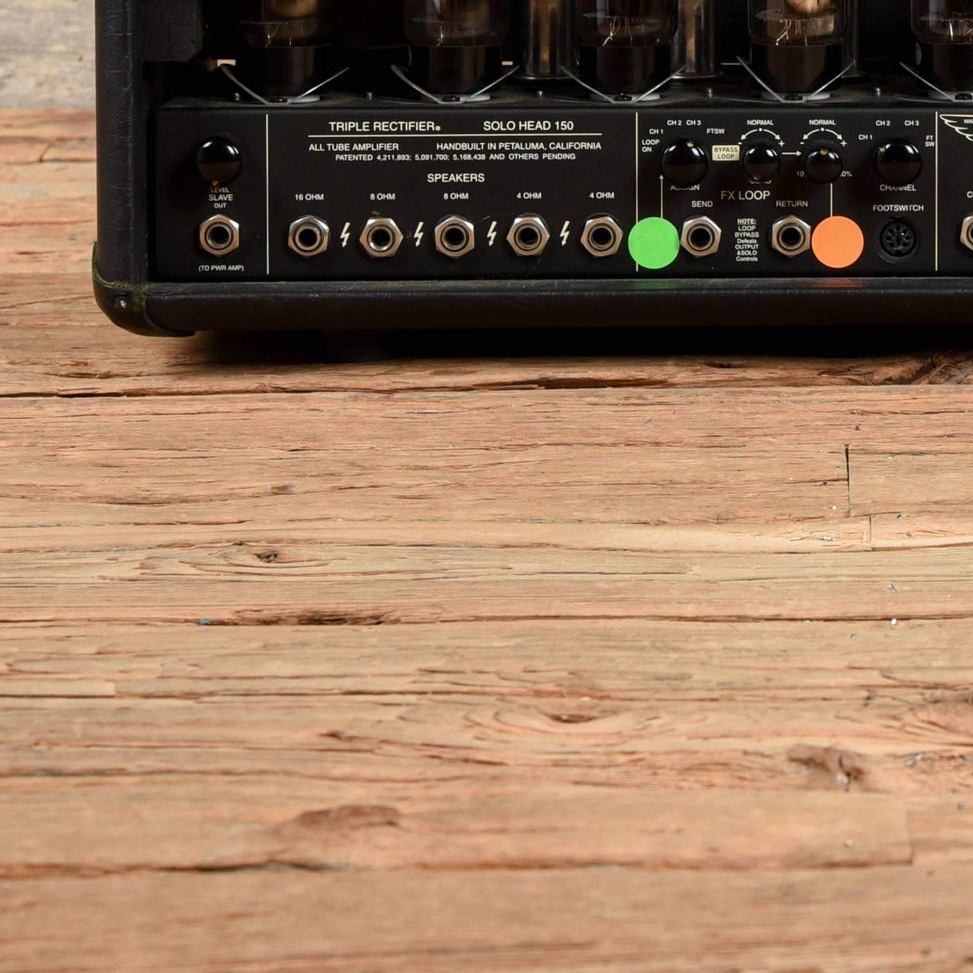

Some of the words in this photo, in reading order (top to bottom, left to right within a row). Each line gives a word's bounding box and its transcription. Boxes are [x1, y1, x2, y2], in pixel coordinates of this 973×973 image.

[329, 122, 370, 132] TRIPLE
[483, 120, 516, 131] SOLO
[519, 120, 551, 130] HEAD
[555, 120, 574, 130] 150
[498, 142, 546, 151] PETALUMA,
[427, 173, 485, 182] SPEAKERS
[721, 190, 735, 200] FX
[738, 190, 770, 200] LOOP
